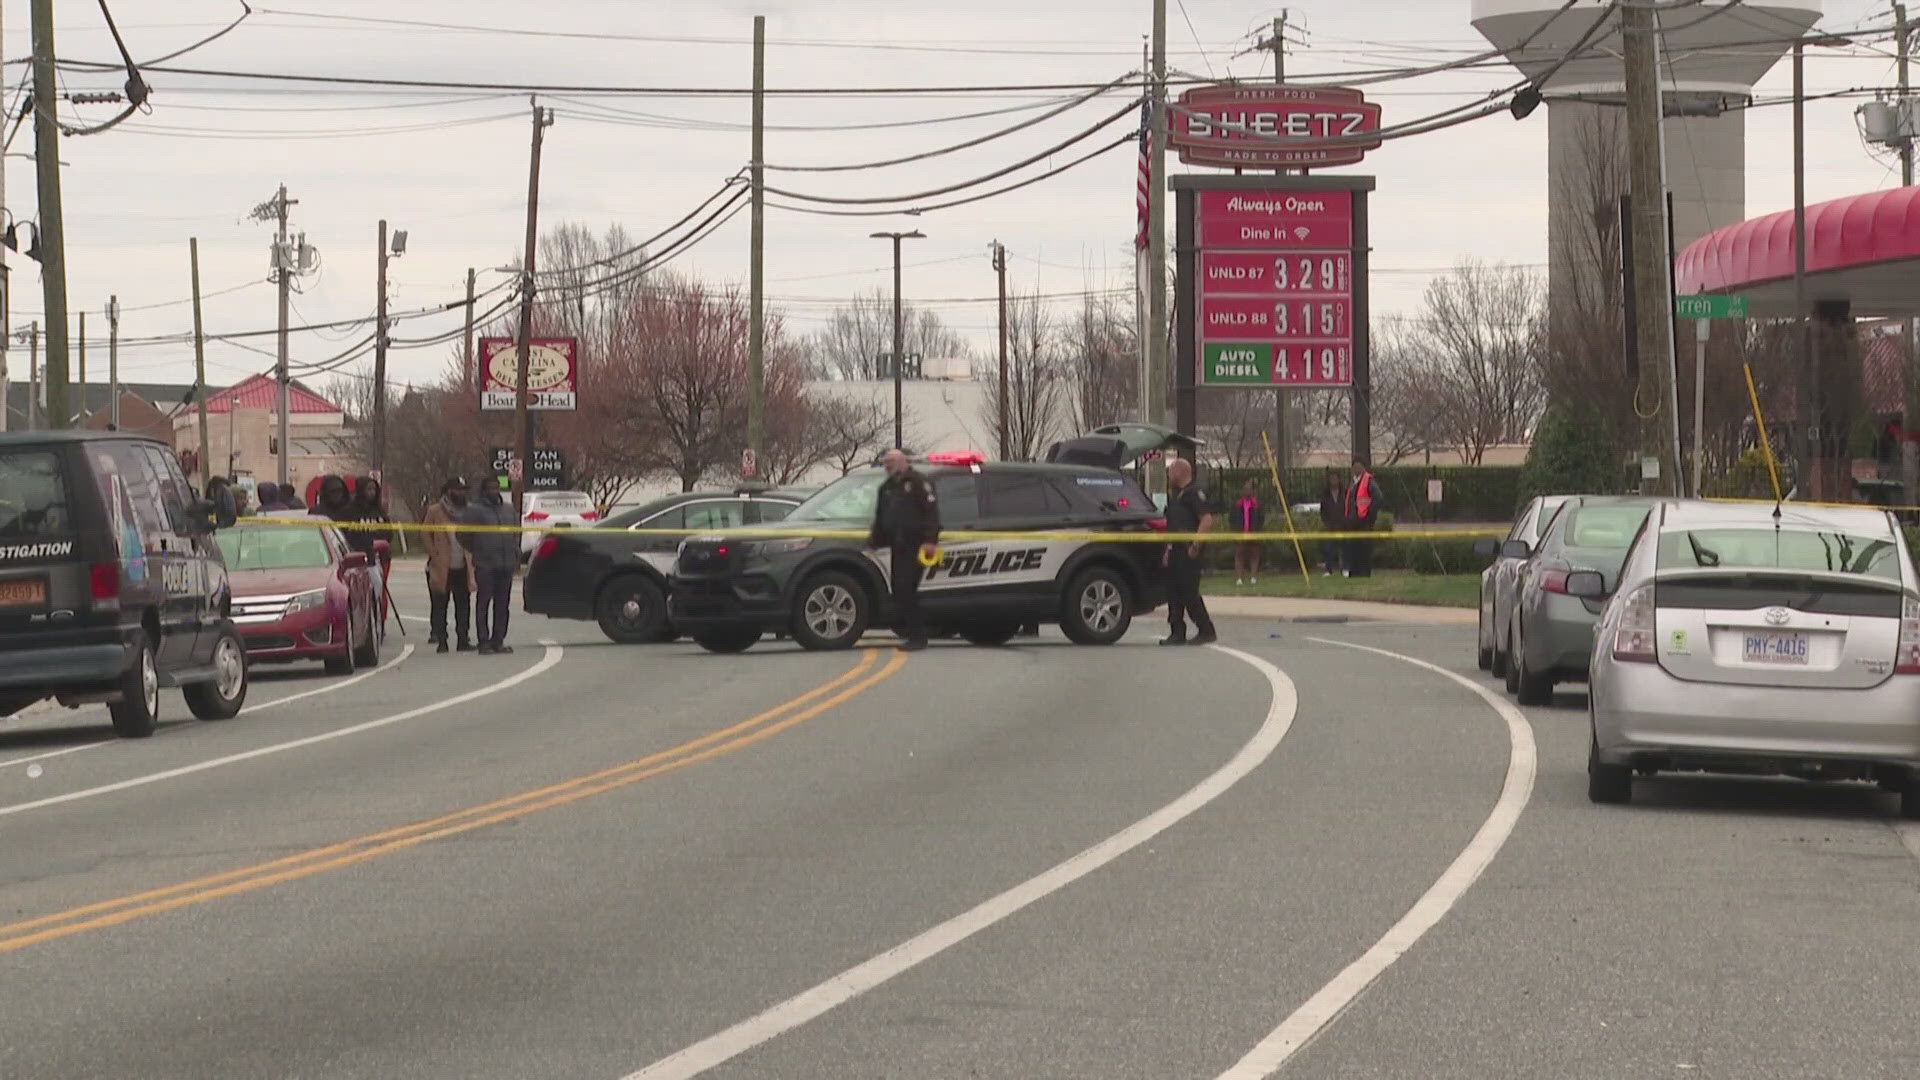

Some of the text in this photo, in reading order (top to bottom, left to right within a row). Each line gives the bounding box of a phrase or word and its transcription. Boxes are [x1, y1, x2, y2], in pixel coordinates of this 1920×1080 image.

[1235, 90, 1316, 101] FRESH FOOD
[1187, 112, 1364, 138] SHEETZ
[1224, 150, 1327, 161] MADE TO ORDER
[1227, 196, 1324, 216] Always Open
[1241, 226, 1287, 240] Dine In
[1209, 267, 1246, 280] UNLD
[1249, 267, 1264, 280] 87
[1274, 257, 1334, 290] 3.29
[1209, 312, 1247, 325] UNLD
[1250, 312, 1268, 325] 88
[1274, 303, 1333, 335] 3.15
[502, 358, 556, 368] CALINA
[1219, 350, 1256, 362] AUTO
[1215, 364, 1260, 377] DIESEL
[1275, 348, 1334, 381] 4.19
[495, 371, 564, 388] DELITESSEN
[540, 394, 570, 406] Head
[497, 450, 558, 460] SPTAN
[493, 461, 561, 470] COONS
[925, 547, 1048, 580] POLICE
[162, 562, 188, 594] POLICE
[1746, 637, 1805, 656] PMY-4416
